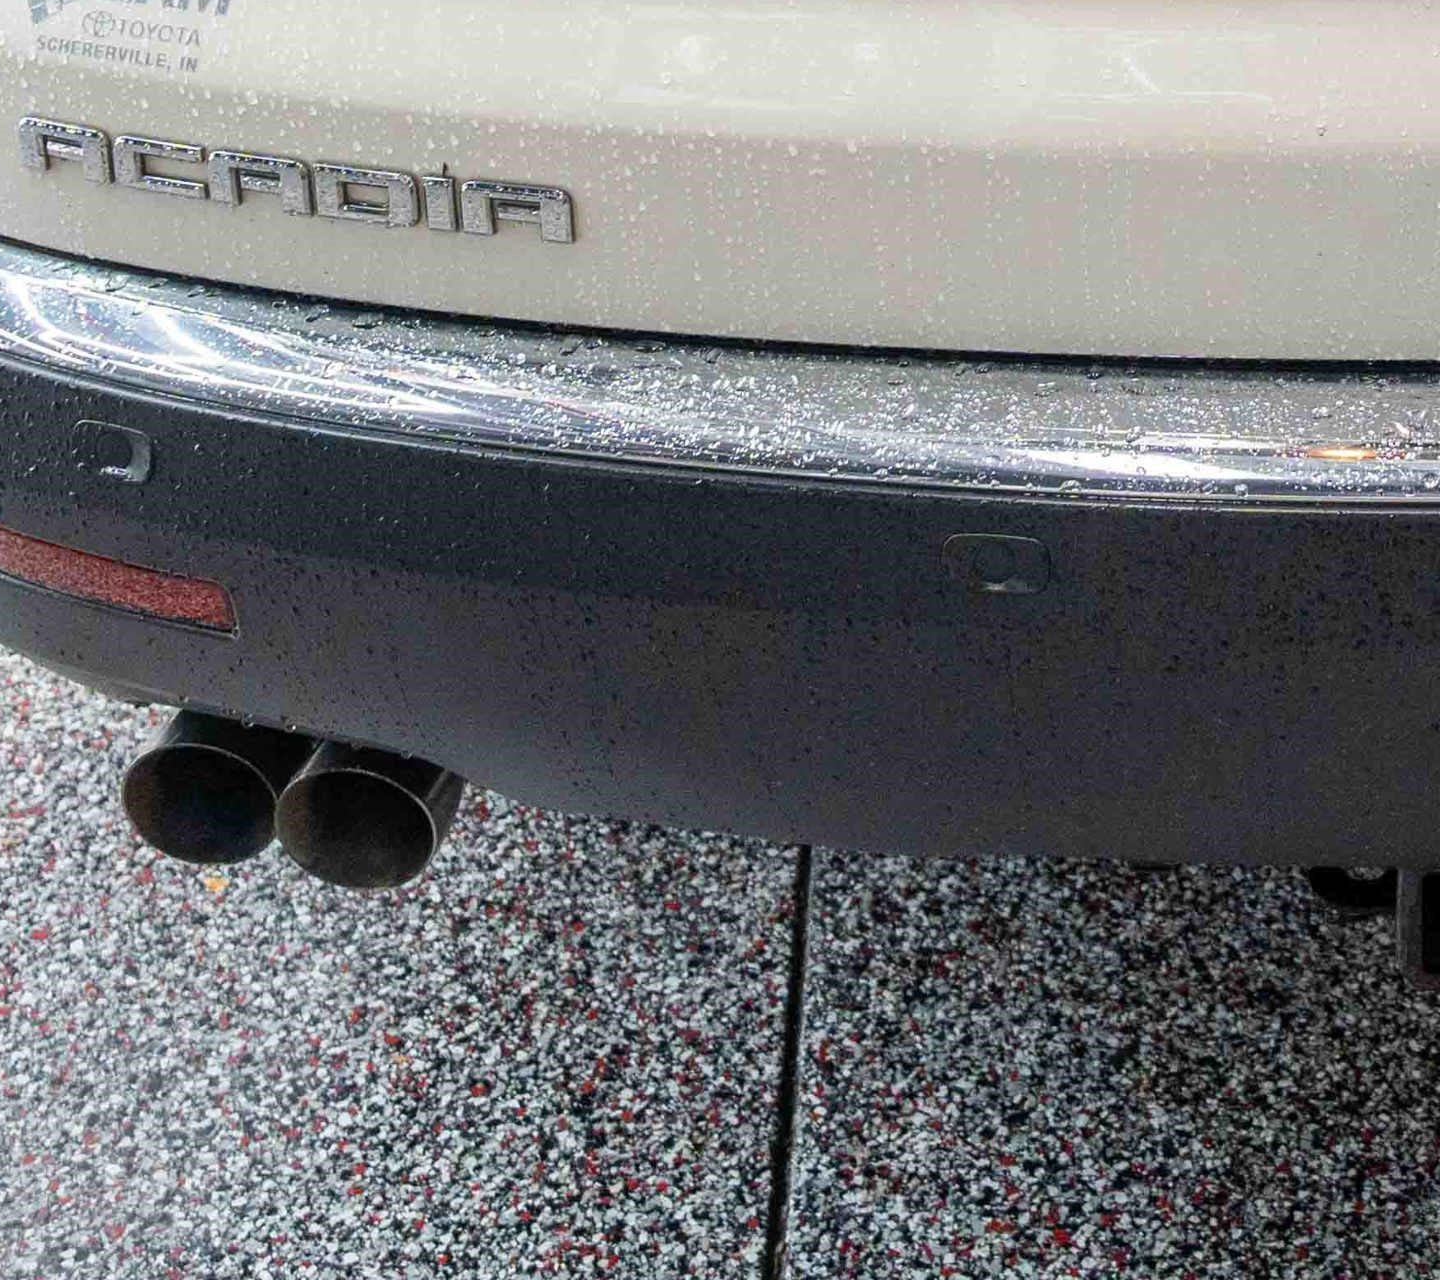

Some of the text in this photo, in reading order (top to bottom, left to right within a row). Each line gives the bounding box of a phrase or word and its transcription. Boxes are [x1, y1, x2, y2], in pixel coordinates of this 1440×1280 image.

[115, 19, 201, 47] TOYOTA
[36, 35, 198, 73] SCHERERVILLE, IN
